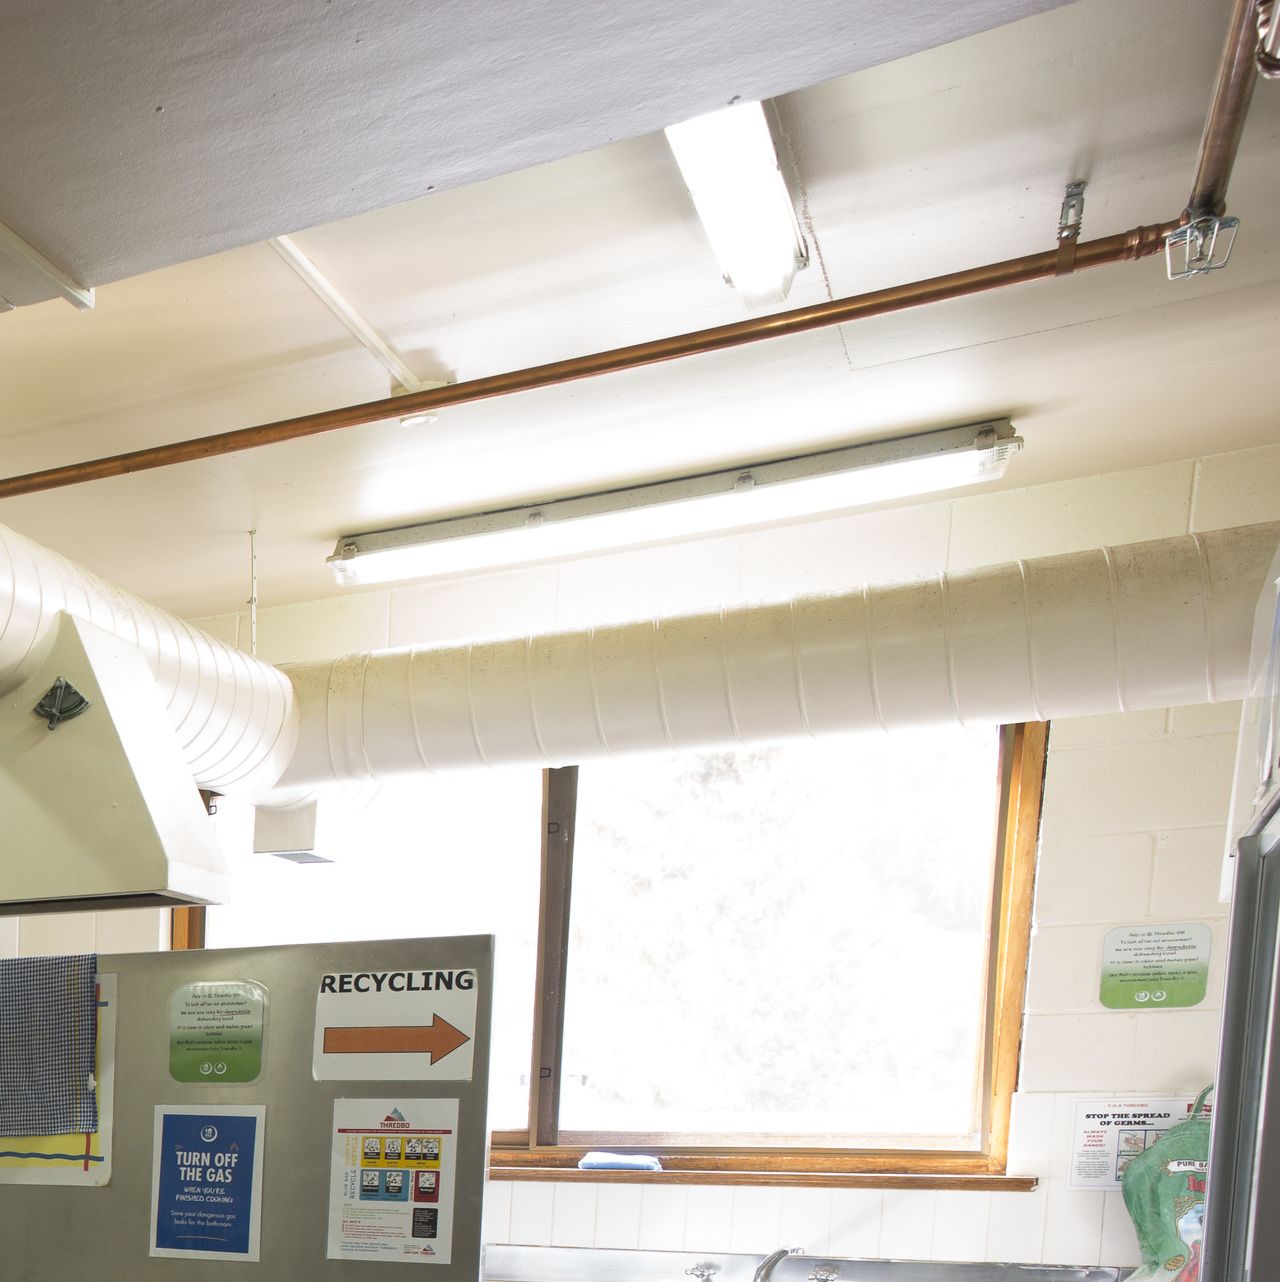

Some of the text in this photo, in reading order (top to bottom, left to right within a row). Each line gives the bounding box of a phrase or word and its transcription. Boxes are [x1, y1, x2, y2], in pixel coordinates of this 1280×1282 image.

[321, 971, 473, 993] RECYCLING
[176, 1152, 238, 1167] TURN OFF
[180, 1167, 233, 1183] THE GAS
[202, 1187, 225, 1195] YOU'RE
[197, 1211, 225, 1219] dangerous
